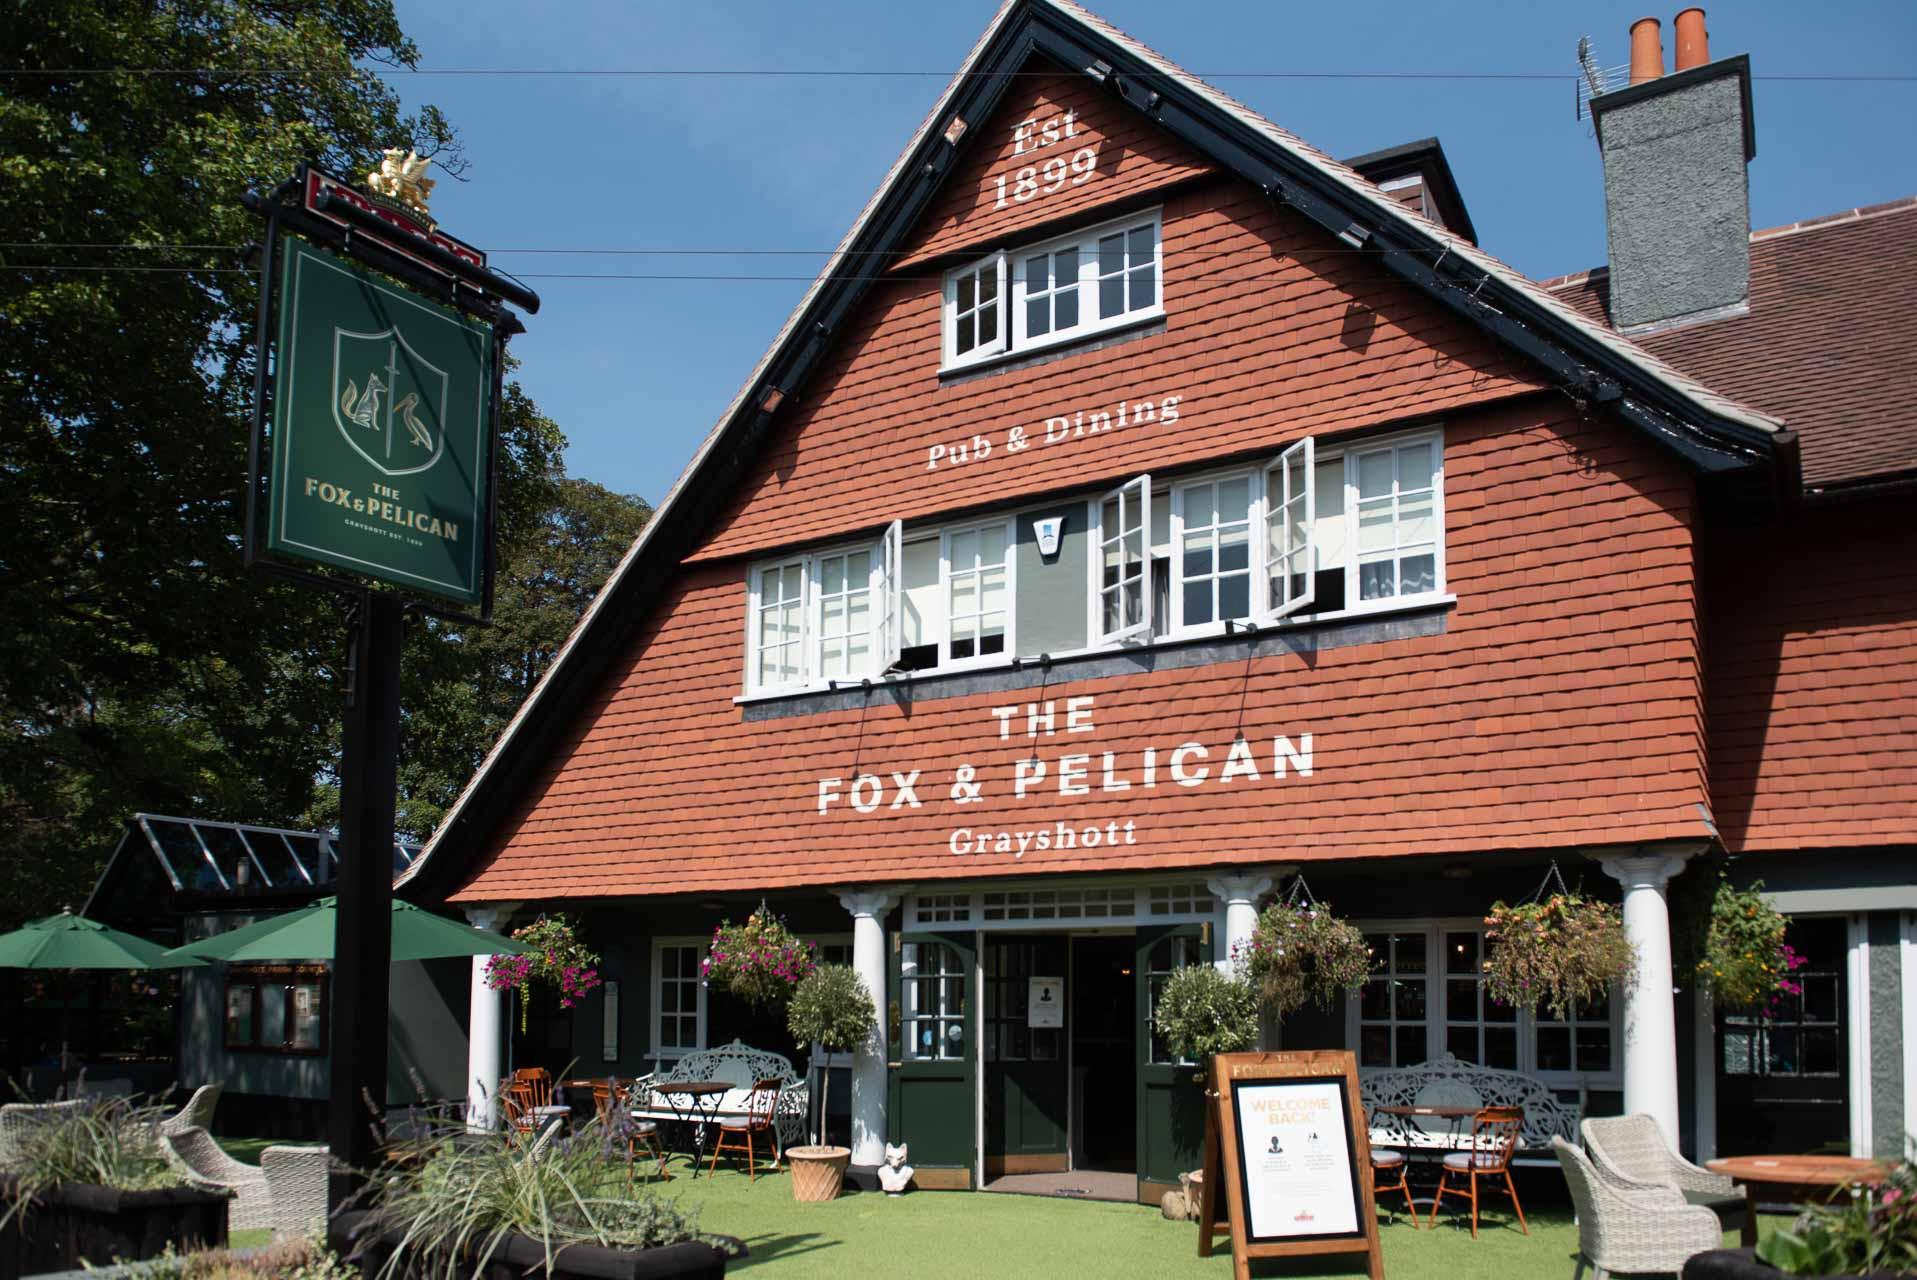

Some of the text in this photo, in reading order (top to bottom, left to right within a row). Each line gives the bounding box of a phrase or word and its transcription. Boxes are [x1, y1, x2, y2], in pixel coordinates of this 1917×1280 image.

[1010, 108, 1080, 158] Est
[992, 148, 1097, 210] 1899
[926, 395, 1183, 470] Pub & Dining
[305, 477, 351, 508] FOX
[367, 496, 458, 541] PELICAN
[372, 482, 400, 500] THE
[991, 696, 1096, 741] THE
[817, 732, 1314, 816] FOX & PELICAN
[949, 819, 1137, 858] Grayshott
[1251, 1097, 1330, 1113] WELCOME
